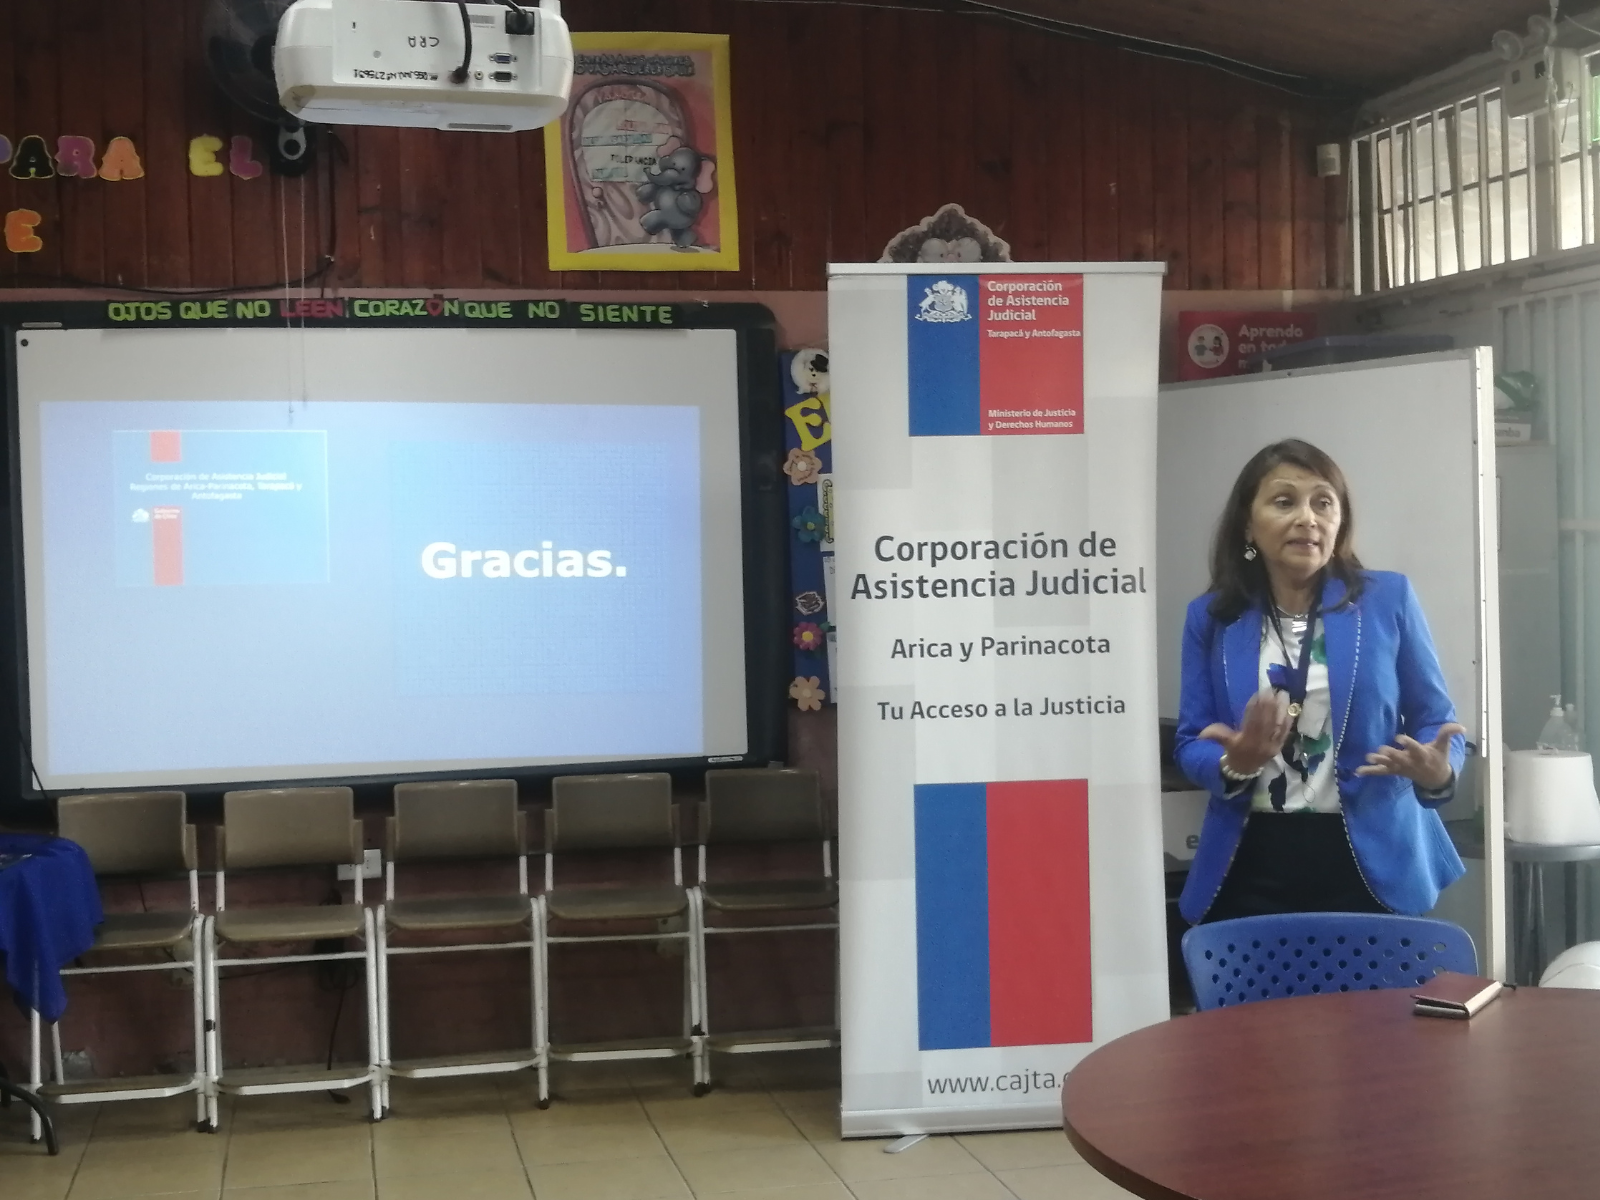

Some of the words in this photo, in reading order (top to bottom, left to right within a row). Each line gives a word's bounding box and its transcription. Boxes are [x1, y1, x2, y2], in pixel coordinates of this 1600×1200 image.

[407, 36, 440, 48] CRA
[987, 280, 1063, 294] Corporación
[987, 295, 1003, 307] de
[1006, 294, 1070, 307] Asistencia
[108, 301, 173, 321] OJOS
[179, 301, 228, 320] QUE
[236, 300, 271, 319] NO
[280, 300, 344, 318] LEEN
[464, 302, 513, 318] QUE
[528, 301, 560, 318] NO
[580, 304, 673, 324] SIENTE
[987, 309, 1037, 321] Judicial
[987, 329, 1024, 339] Tarapacá
[1025, 331, 1031, 339] y
[1032, 329, 1082, 339] Antofagasta
[1238, 343, 1256, 354] en
[988, 409, 1031, 418] Ministerio
[1033, 409, 1043, 417] de
[1044, 408, 1077, 417] Justicia
[988, 421, 994, 430] y
[995, 421, 1034, 429] Derechos
[1035, 420, 1074, 429] Humanos
[874, 532, 1068, 567] Corporación
[1078, 531, 1117, 558] de
[421, 540, 627, 579] Gracias.
[850, 570, 1015, 600] Asistencia
[1026, 566, 1147, 597] Judicial
[891, 638, 952, 659] Arica
[959, 641, 974, 662] y
[981, 635, 1111, 657] Parinacota
[877, 701, 903, 720] Tu
[910, 700, 988, 720] Acceso
[994, 703, 1007, 717] a
[1013, 698, 1033, 717] la
[1040, 695, 1126, 716] Justicia
